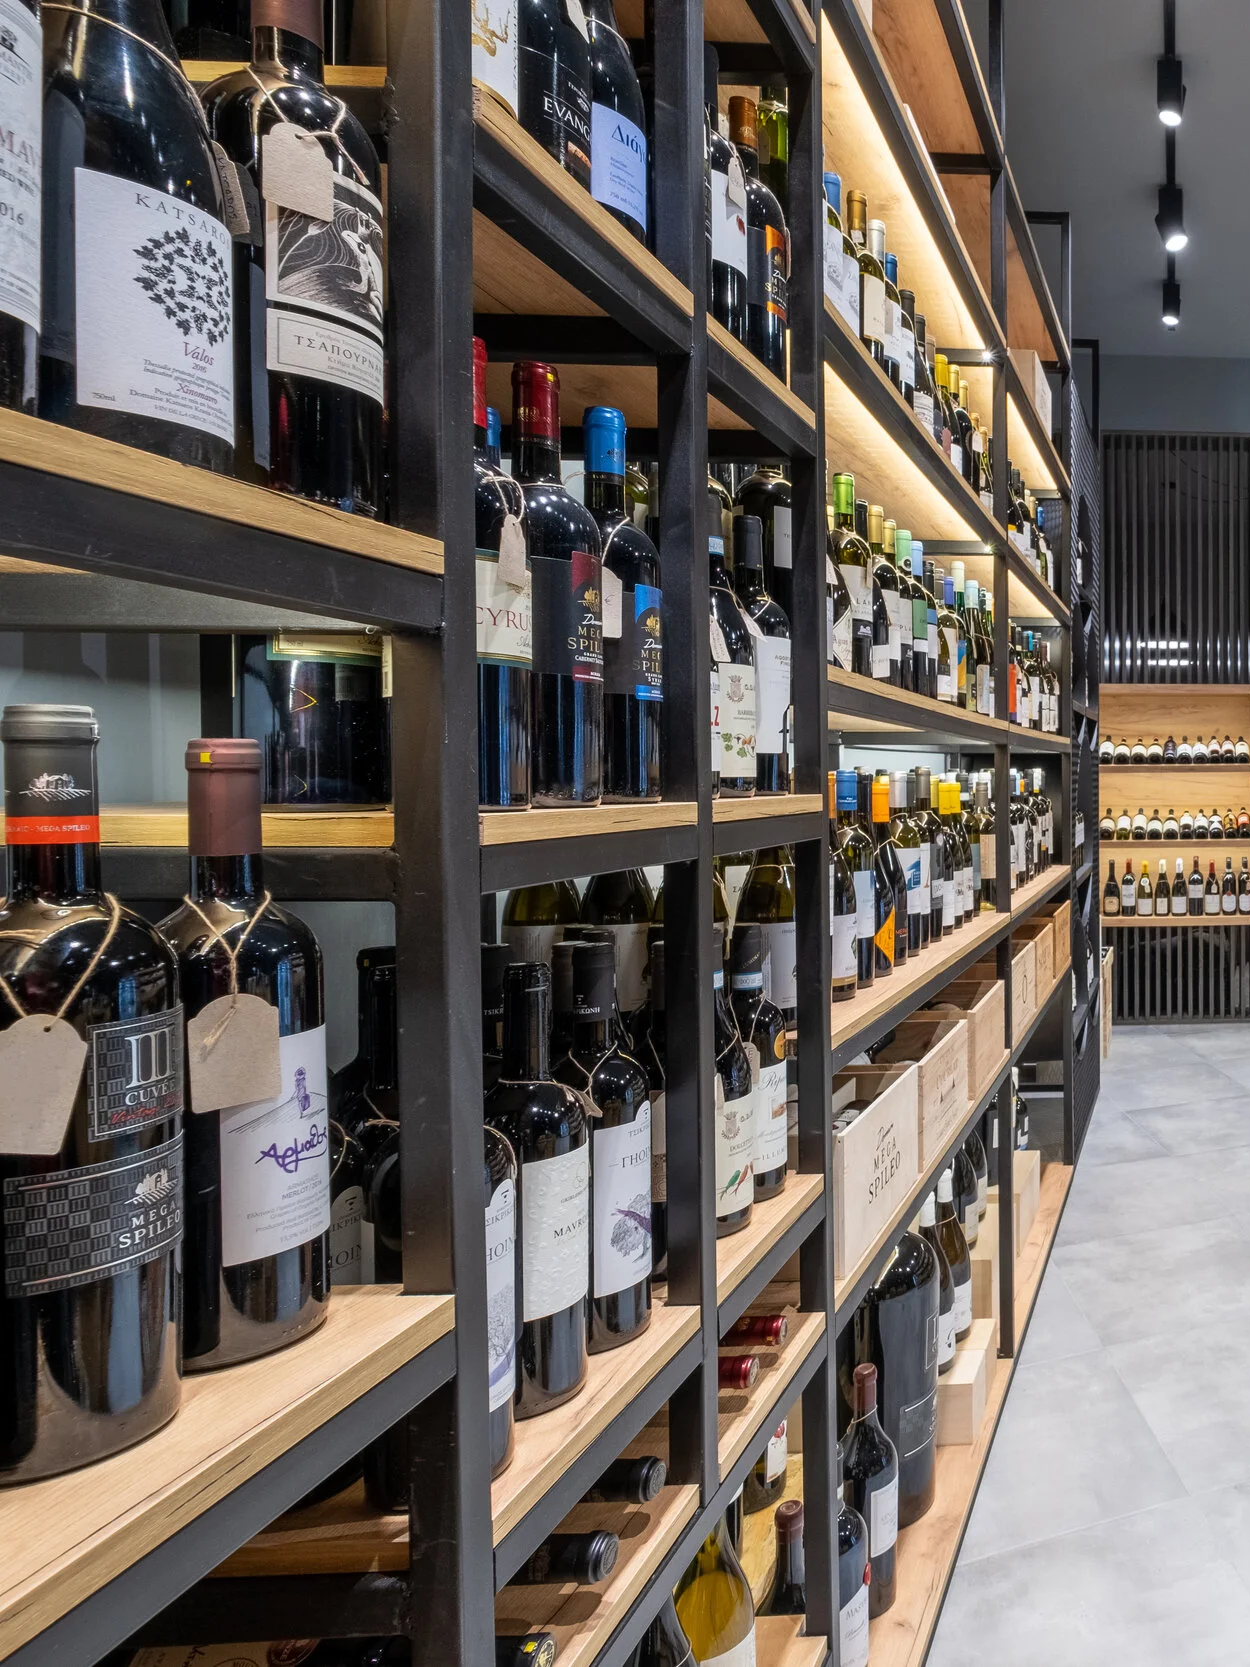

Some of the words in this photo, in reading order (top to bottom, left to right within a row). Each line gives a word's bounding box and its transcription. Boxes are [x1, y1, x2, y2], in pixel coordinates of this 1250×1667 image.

[183, 341, 215, 366] Valos
[62, 824, 91, 833] SPILEO
[873, 1136, 897, 1175] MEGA
[868, 1150, 901, 1205] SPILEO
[118, 1209, 181, 1249] SPILEO
[131, 1200, 176, 1229] MEGA
